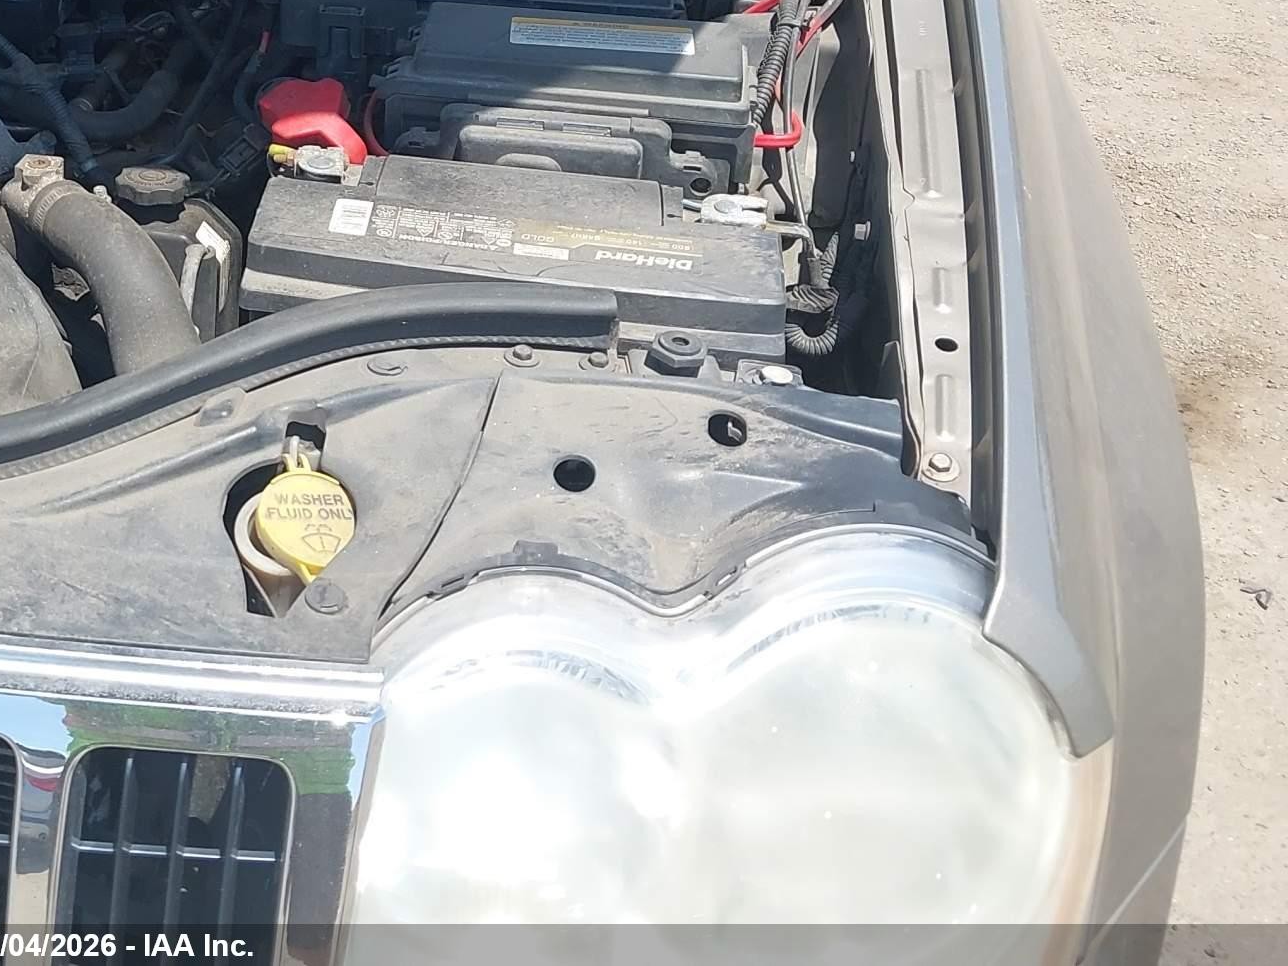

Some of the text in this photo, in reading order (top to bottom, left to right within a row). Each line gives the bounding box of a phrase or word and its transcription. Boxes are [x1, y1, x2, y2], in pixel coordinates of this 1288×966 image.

[521, 233, 555, 244] GOLD
[594, 249, 694, 270] DieHard
[274, 494, 344, 506] WASHER
[266, 507, 313, 521] FLUID
